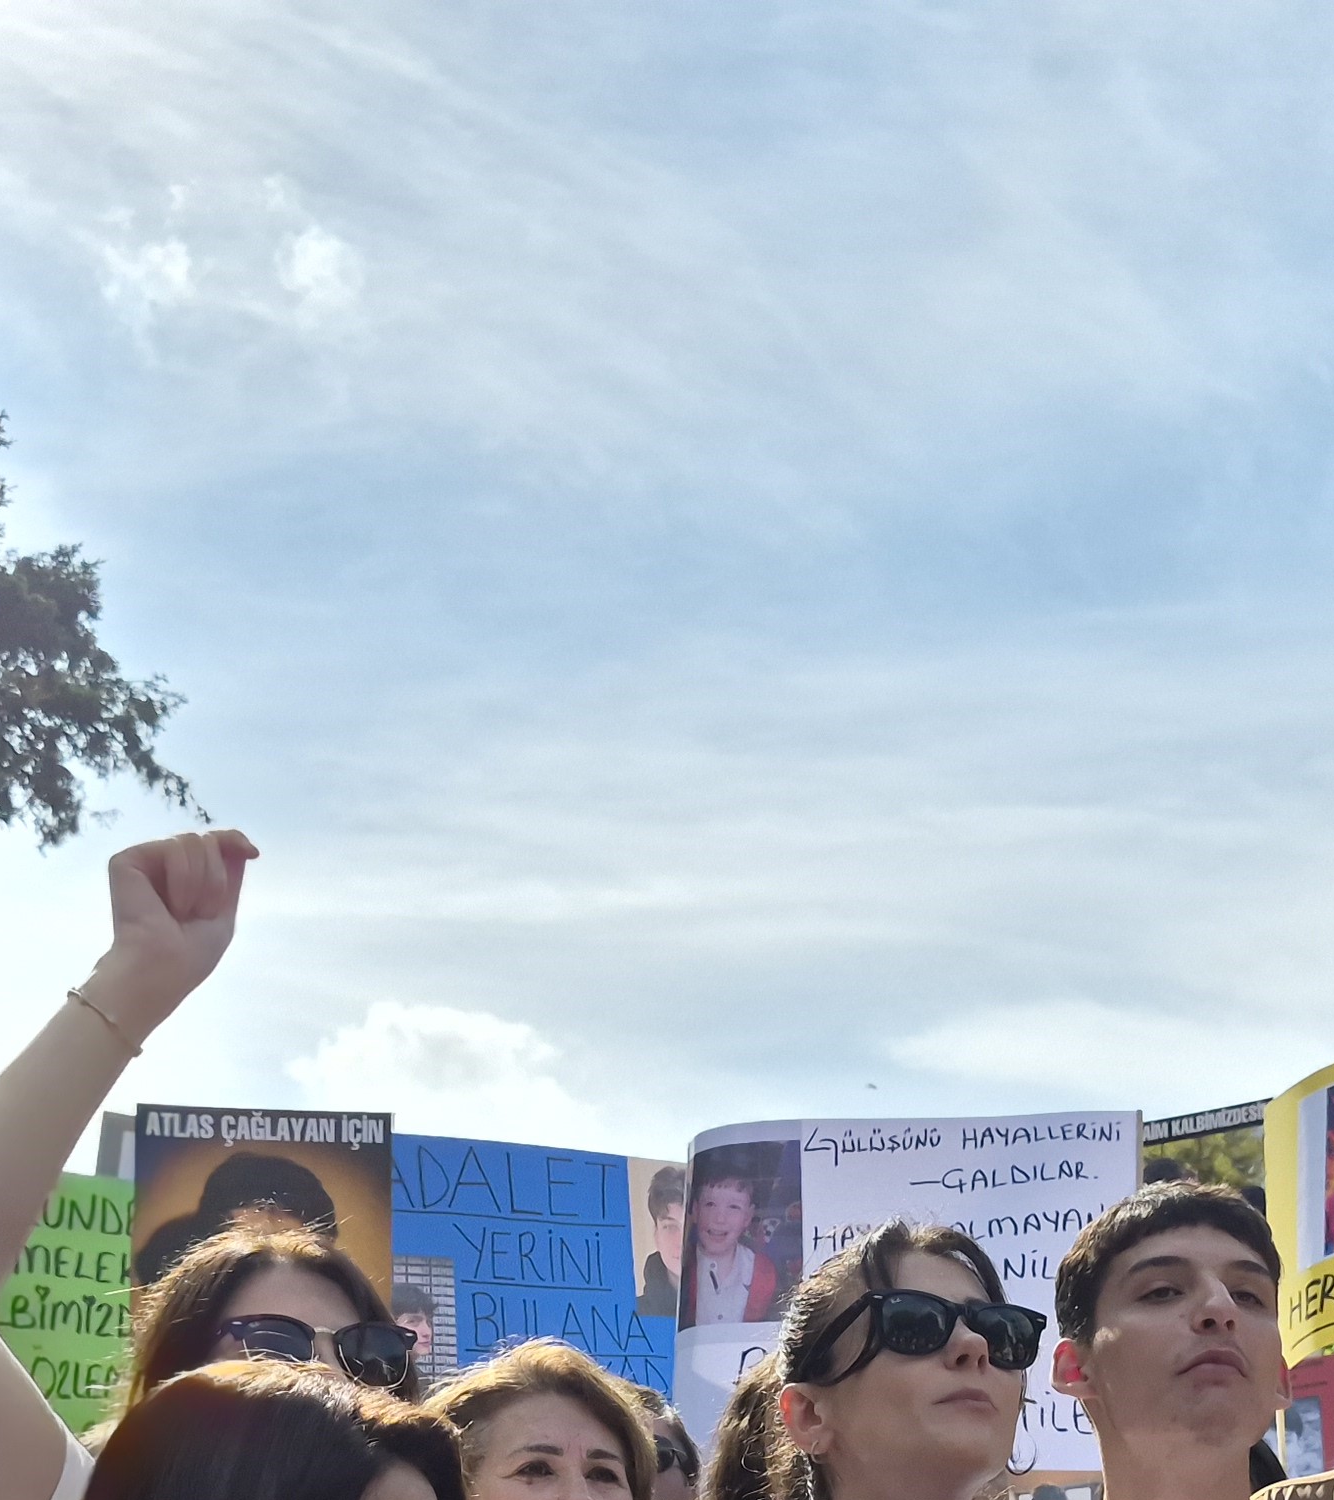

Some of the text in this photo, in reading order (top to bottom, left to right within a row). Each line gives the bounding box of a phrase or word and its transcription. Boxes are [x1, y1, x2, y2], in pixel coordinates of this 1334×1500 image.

[145, 1111, 385, 1151] ATLAS ÇAĞLAYAN İÇİN
[962, 1121, 1123, 1150] HAYALLERİNİ
[452, 1223, 603, 1286] YERİNİ
